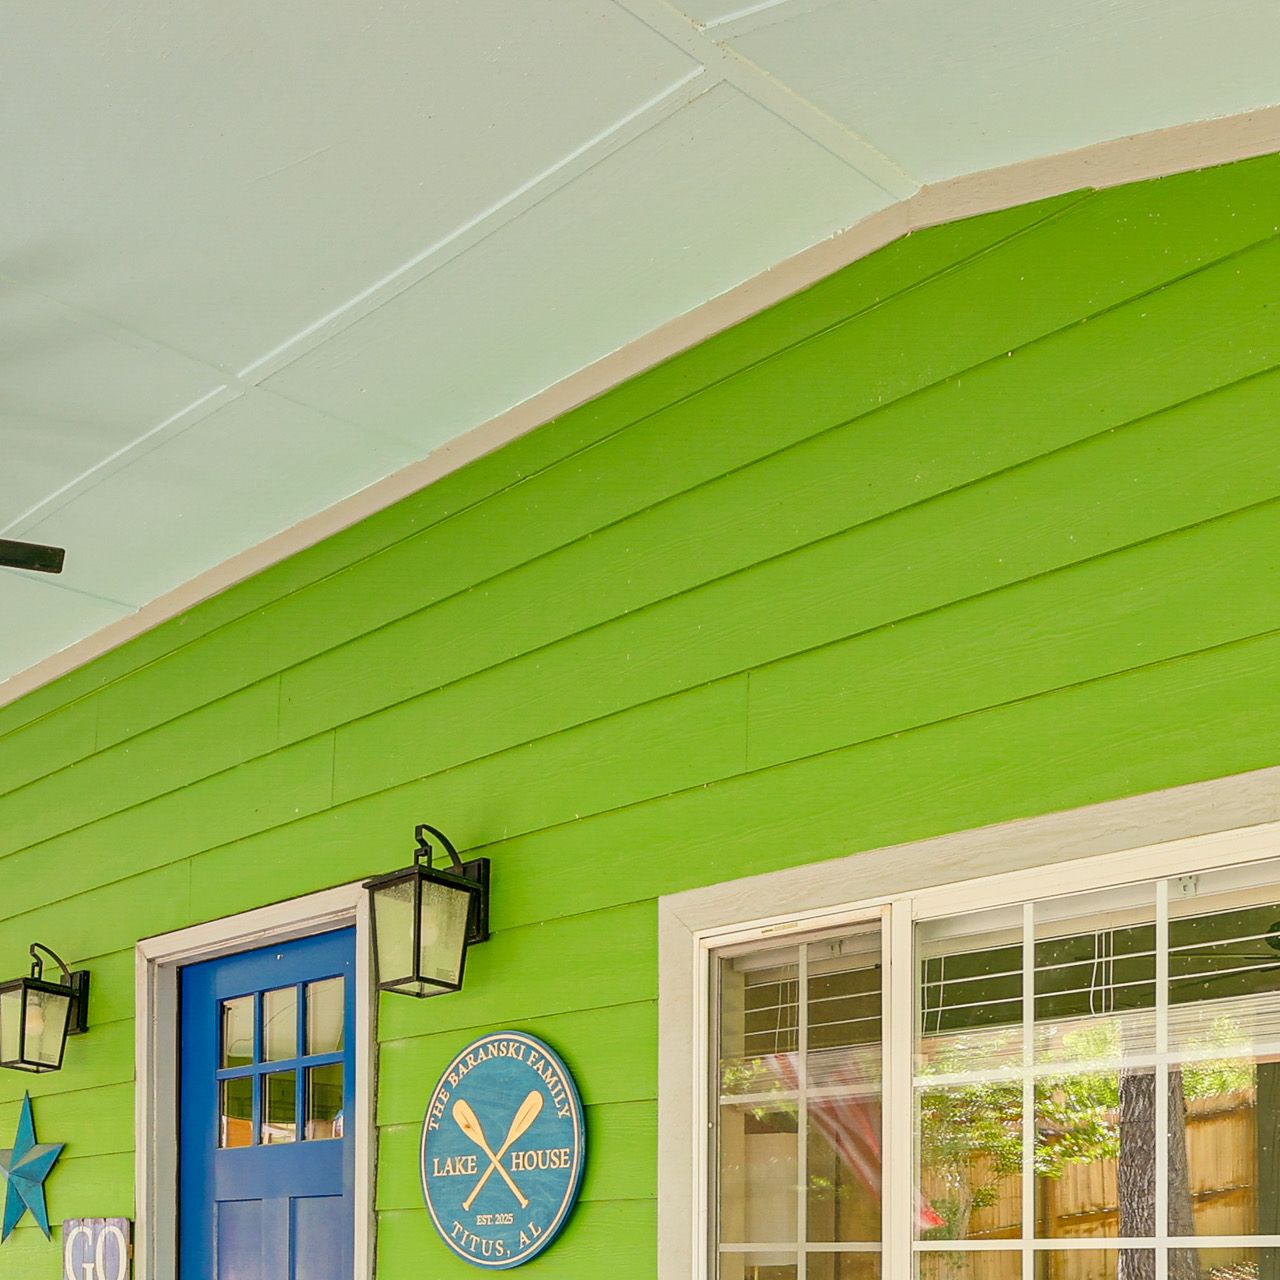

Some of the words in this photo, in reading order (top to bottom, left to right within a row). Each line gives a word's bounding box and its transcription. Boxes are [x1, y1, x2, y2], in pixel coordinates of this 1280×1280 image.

[429, 1090, 450, 1131] THE
[448, 1042, 526, 1087] BARANSKI
[527, 1053, 571, 1119] FAMILY
[433, 1155, 477, 1177] LAKE
[511, 1148, 570, 1171] HOUSE
[495, 1214, 513, 1224] 2025
[451, 1221, 511, 1257] TITUS,
[518, 1222, 542, 1249] AL
